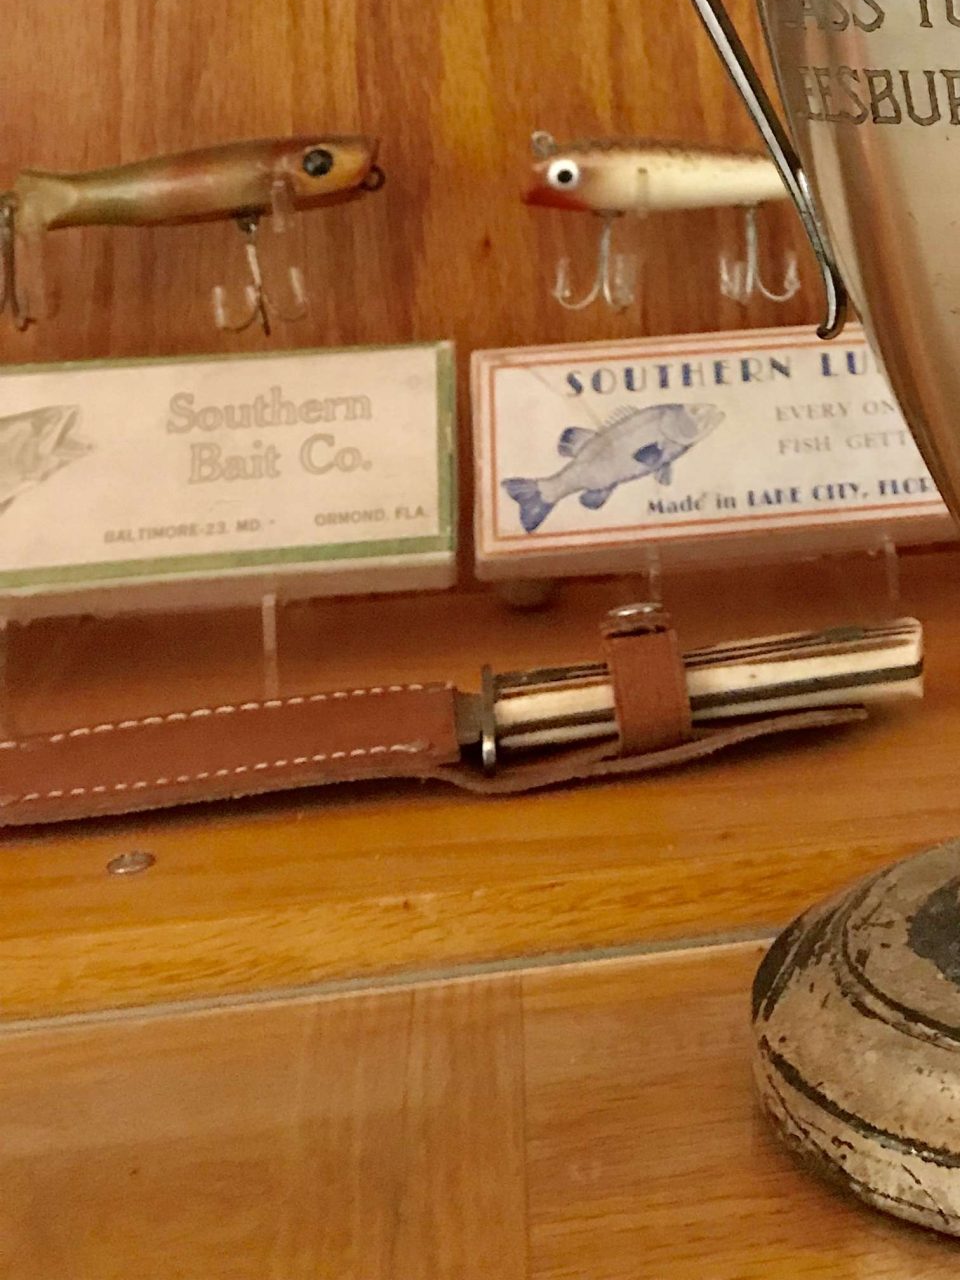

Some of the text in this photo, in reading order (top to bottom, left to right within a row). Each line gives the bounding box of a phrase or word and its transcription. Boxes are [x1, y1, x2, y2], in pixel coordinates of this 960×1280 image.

[565, 354, 791, 396] SOUTHERN
[165, 385, 373, 434] Southern
[775, 402, 848, 422] EVERY
[188, 432, 373, 485] Bait Co.
[778, 436, 832, 456] FISH
[647, 494, 703, 517] Made
[716, 493, 737, 510] in
